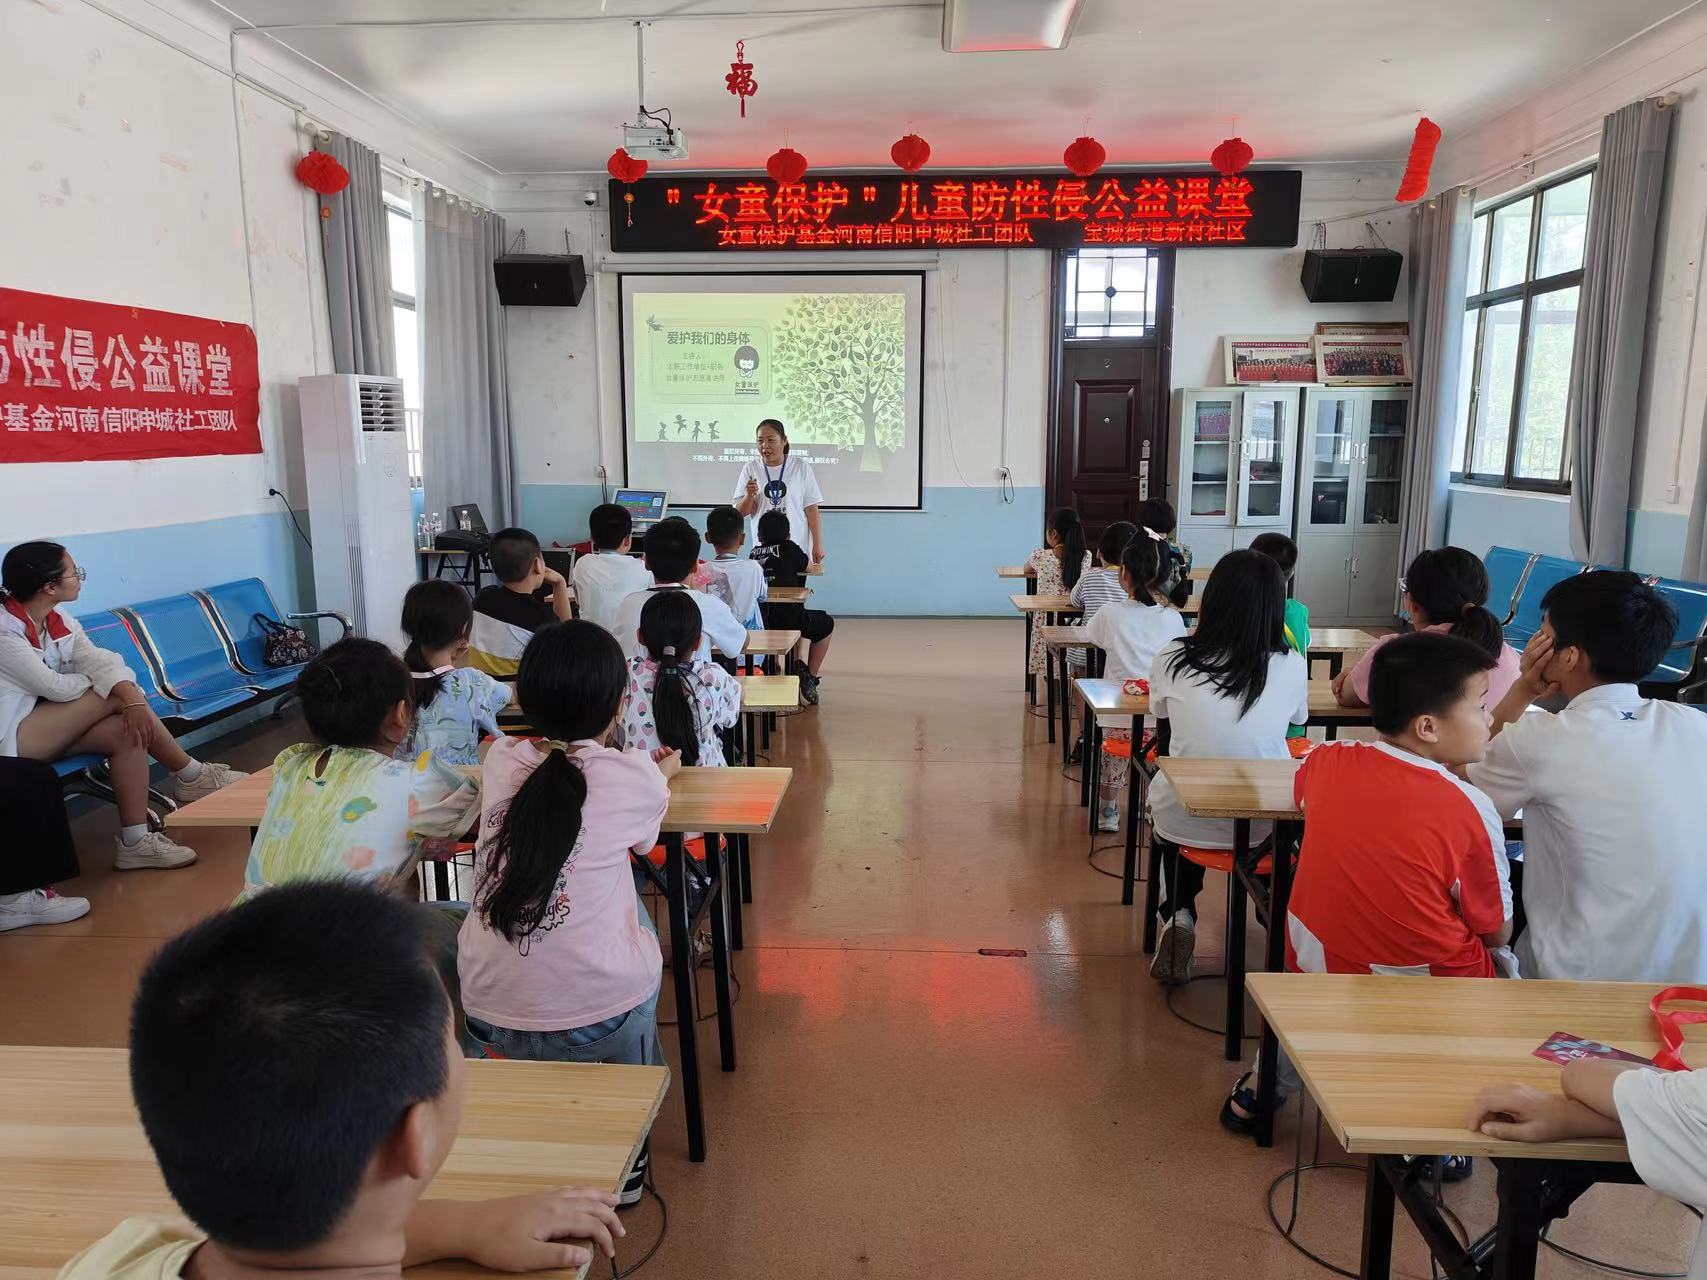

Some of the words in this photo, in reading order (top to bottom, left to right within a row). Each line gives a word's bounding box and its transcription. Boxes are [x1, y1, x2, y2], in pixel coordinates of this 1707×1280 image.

[725, 63, 758, 97] 福
[717, 222, 1034, 246] 女童保护基金河南信阳申城社工团队
[667, 331, 750, 345] 爱护我们的身体
[0, 402, 238, 434] 基金河南信阳申城社工团队
